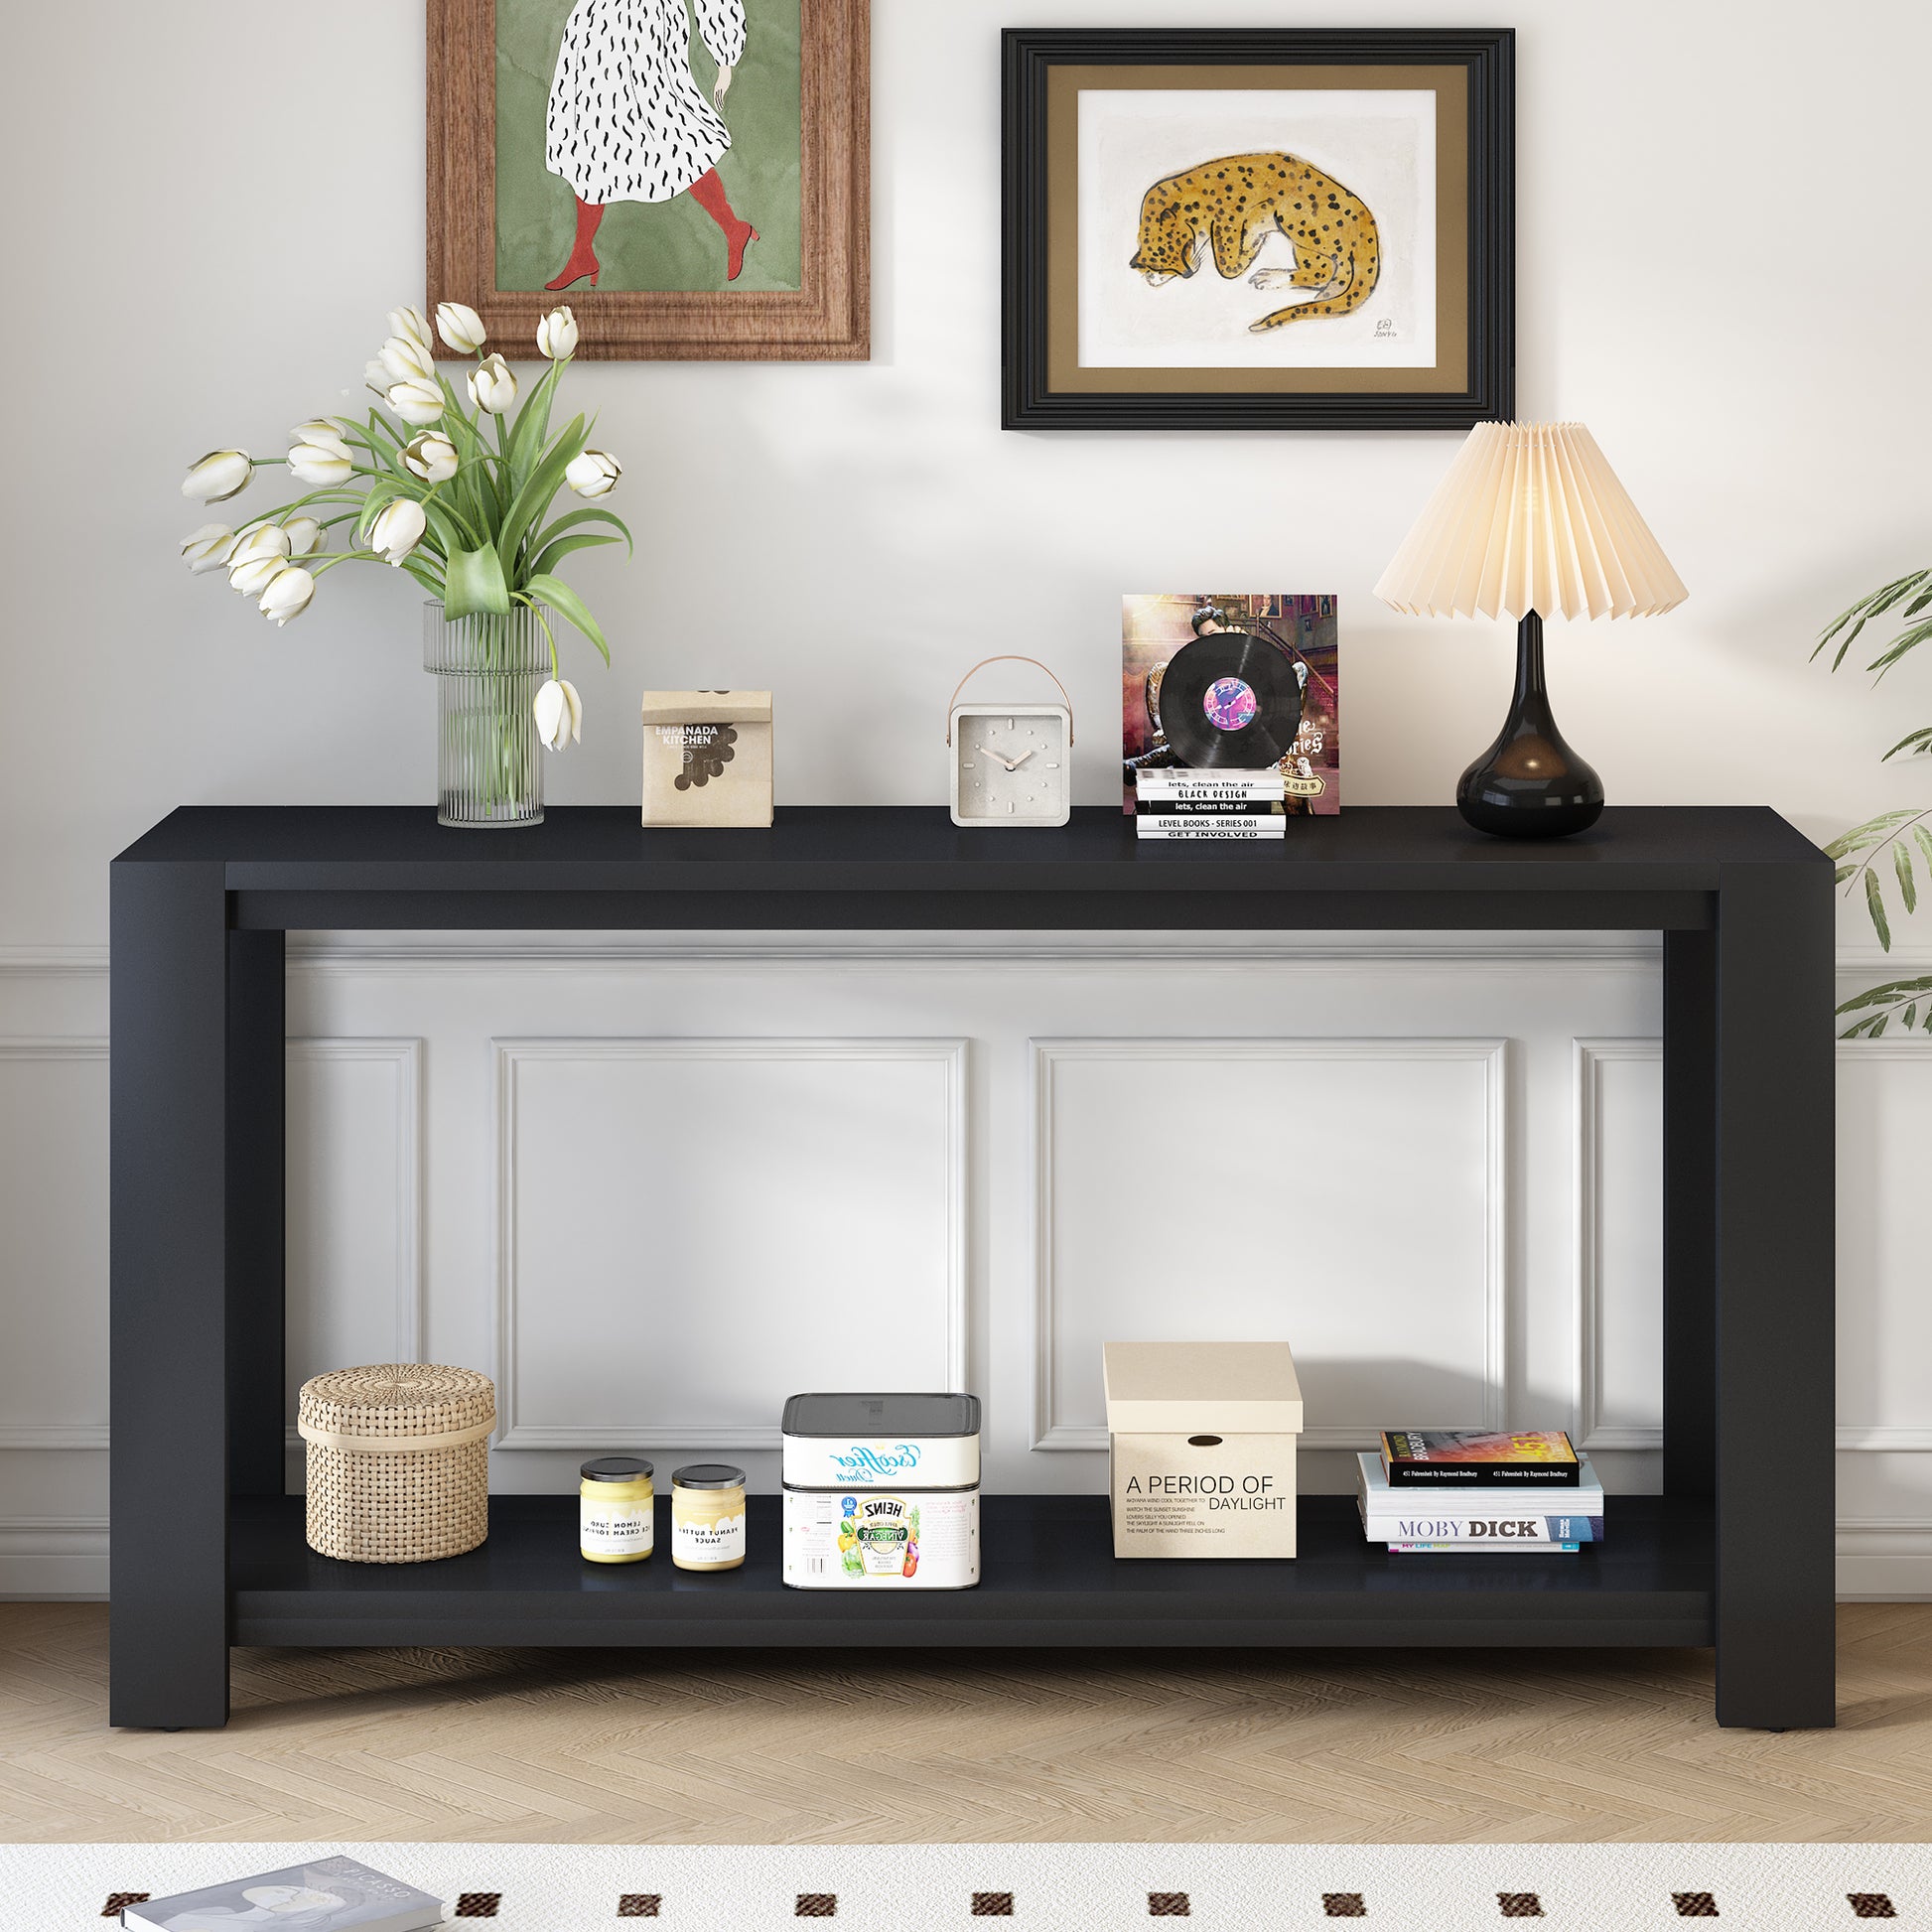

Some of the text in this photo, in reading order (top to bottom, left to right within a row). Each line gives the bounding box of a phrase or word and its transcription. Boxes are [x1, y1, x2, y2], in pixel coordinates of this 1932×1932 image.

[655, 726, 719, 736] EMPANADA
[662, 735, 712, 745] KITCHEN
[1175, 802, 1193, 811] lets,
[1406, 1432, 1430, 1459] BRADBURY
[1511, 1437, 1547, 1456] 451
[1126, 1475, 1273, 1494] A PERIOD OF
[1209, 1497, 1287, 1510] DAYLIGHT
[1399, 1521, 1538, 1537] MOBY DICK
[343, 1868, 411, 1898] PICASSO
